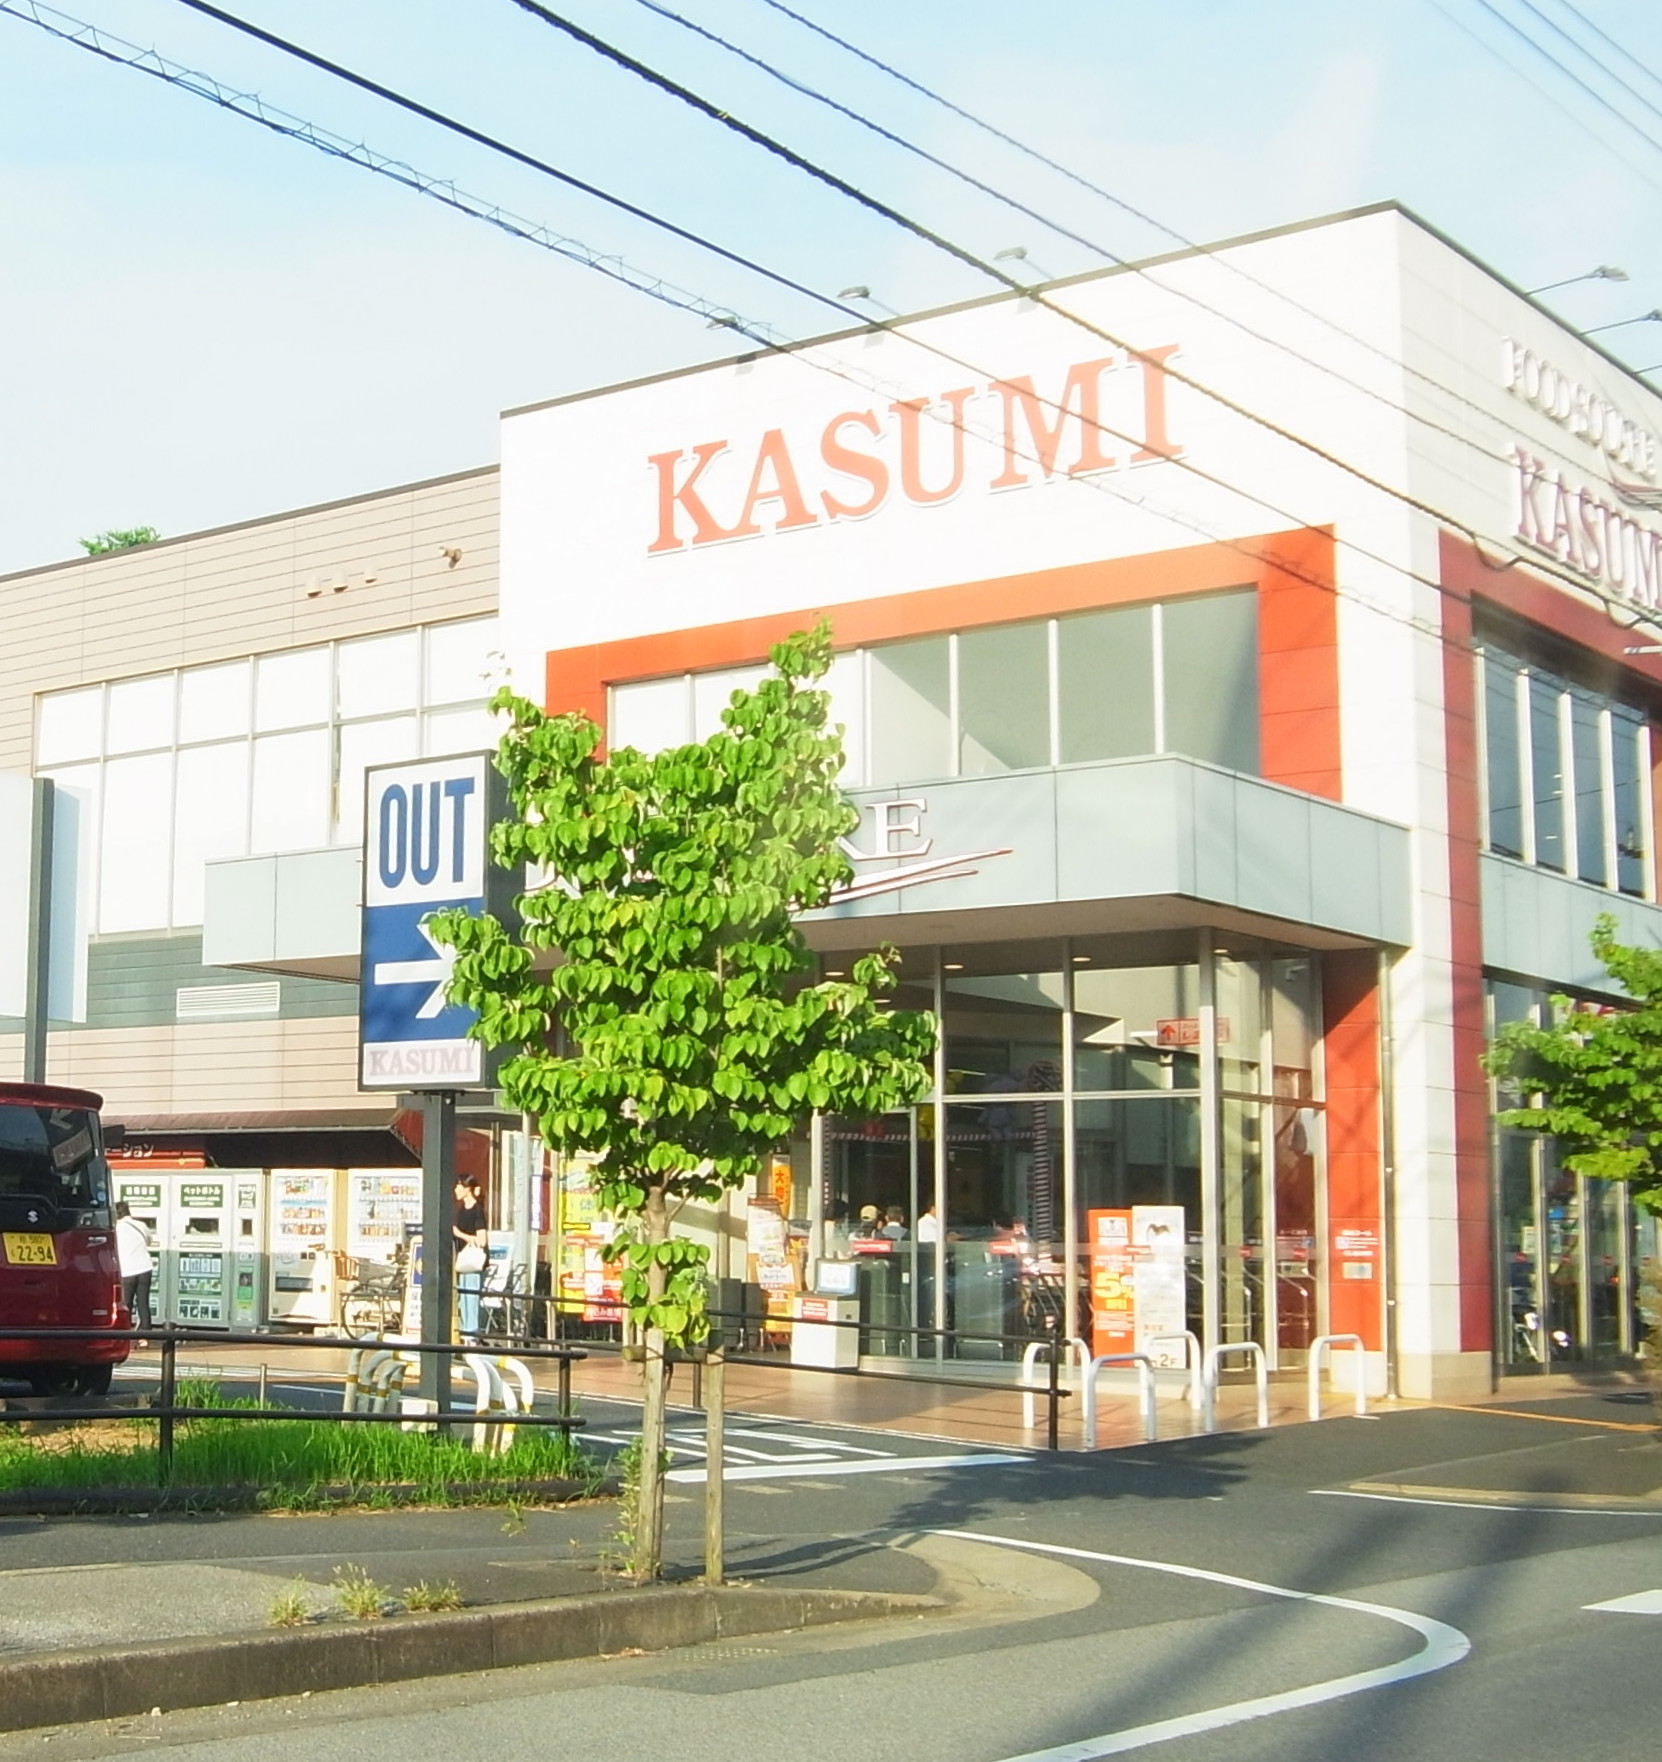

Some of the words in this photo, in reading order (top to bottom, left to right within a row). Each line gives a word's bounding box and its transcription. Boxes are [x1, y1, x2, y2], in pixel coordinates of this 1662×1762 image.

[647, 343, 1185, 557] KASUMI
[379, 776, 475, 889] OUT
[369, 1046, 475, 1076] KASUMI
